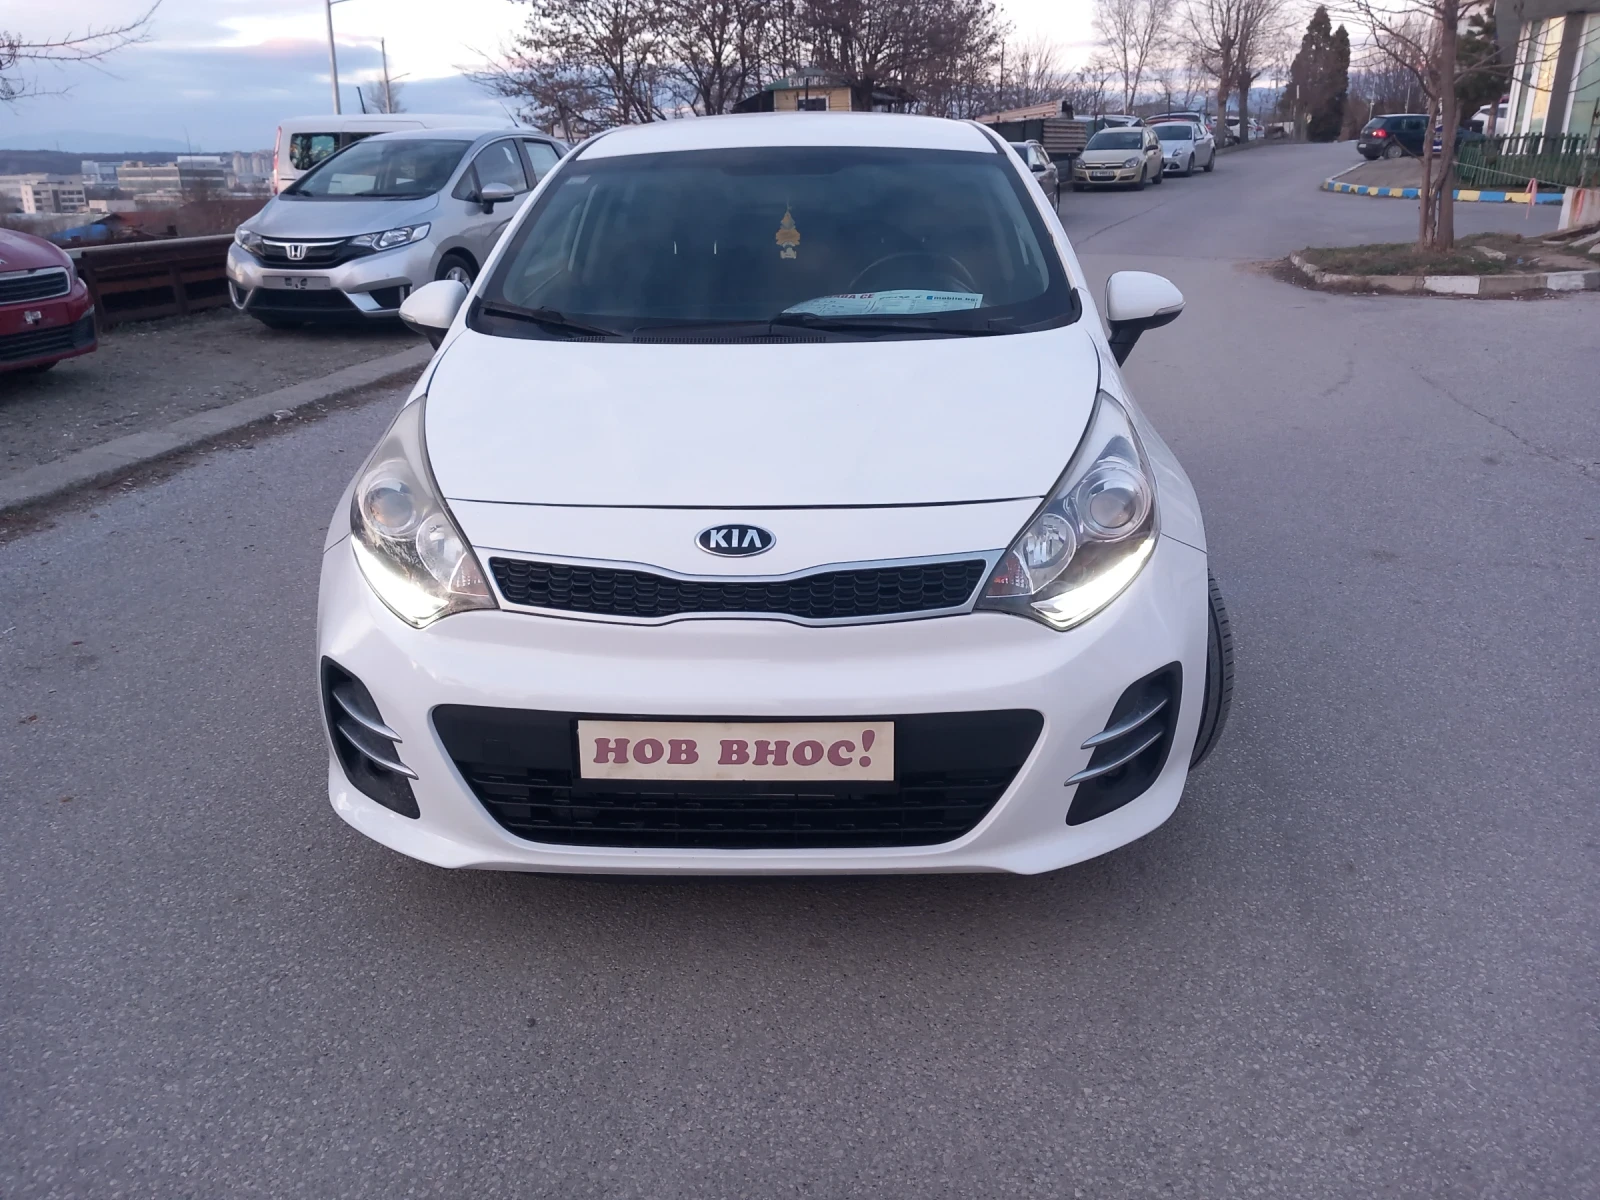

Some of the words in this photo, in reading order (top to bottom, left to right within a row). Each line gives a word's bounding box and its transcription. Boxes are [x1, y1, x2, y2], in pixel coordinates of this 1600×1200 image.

[709, 529, 762, 548] KIA
[593, 737, 700, 765] НОВ
[718, 729, 876, 768] ВНОС!
